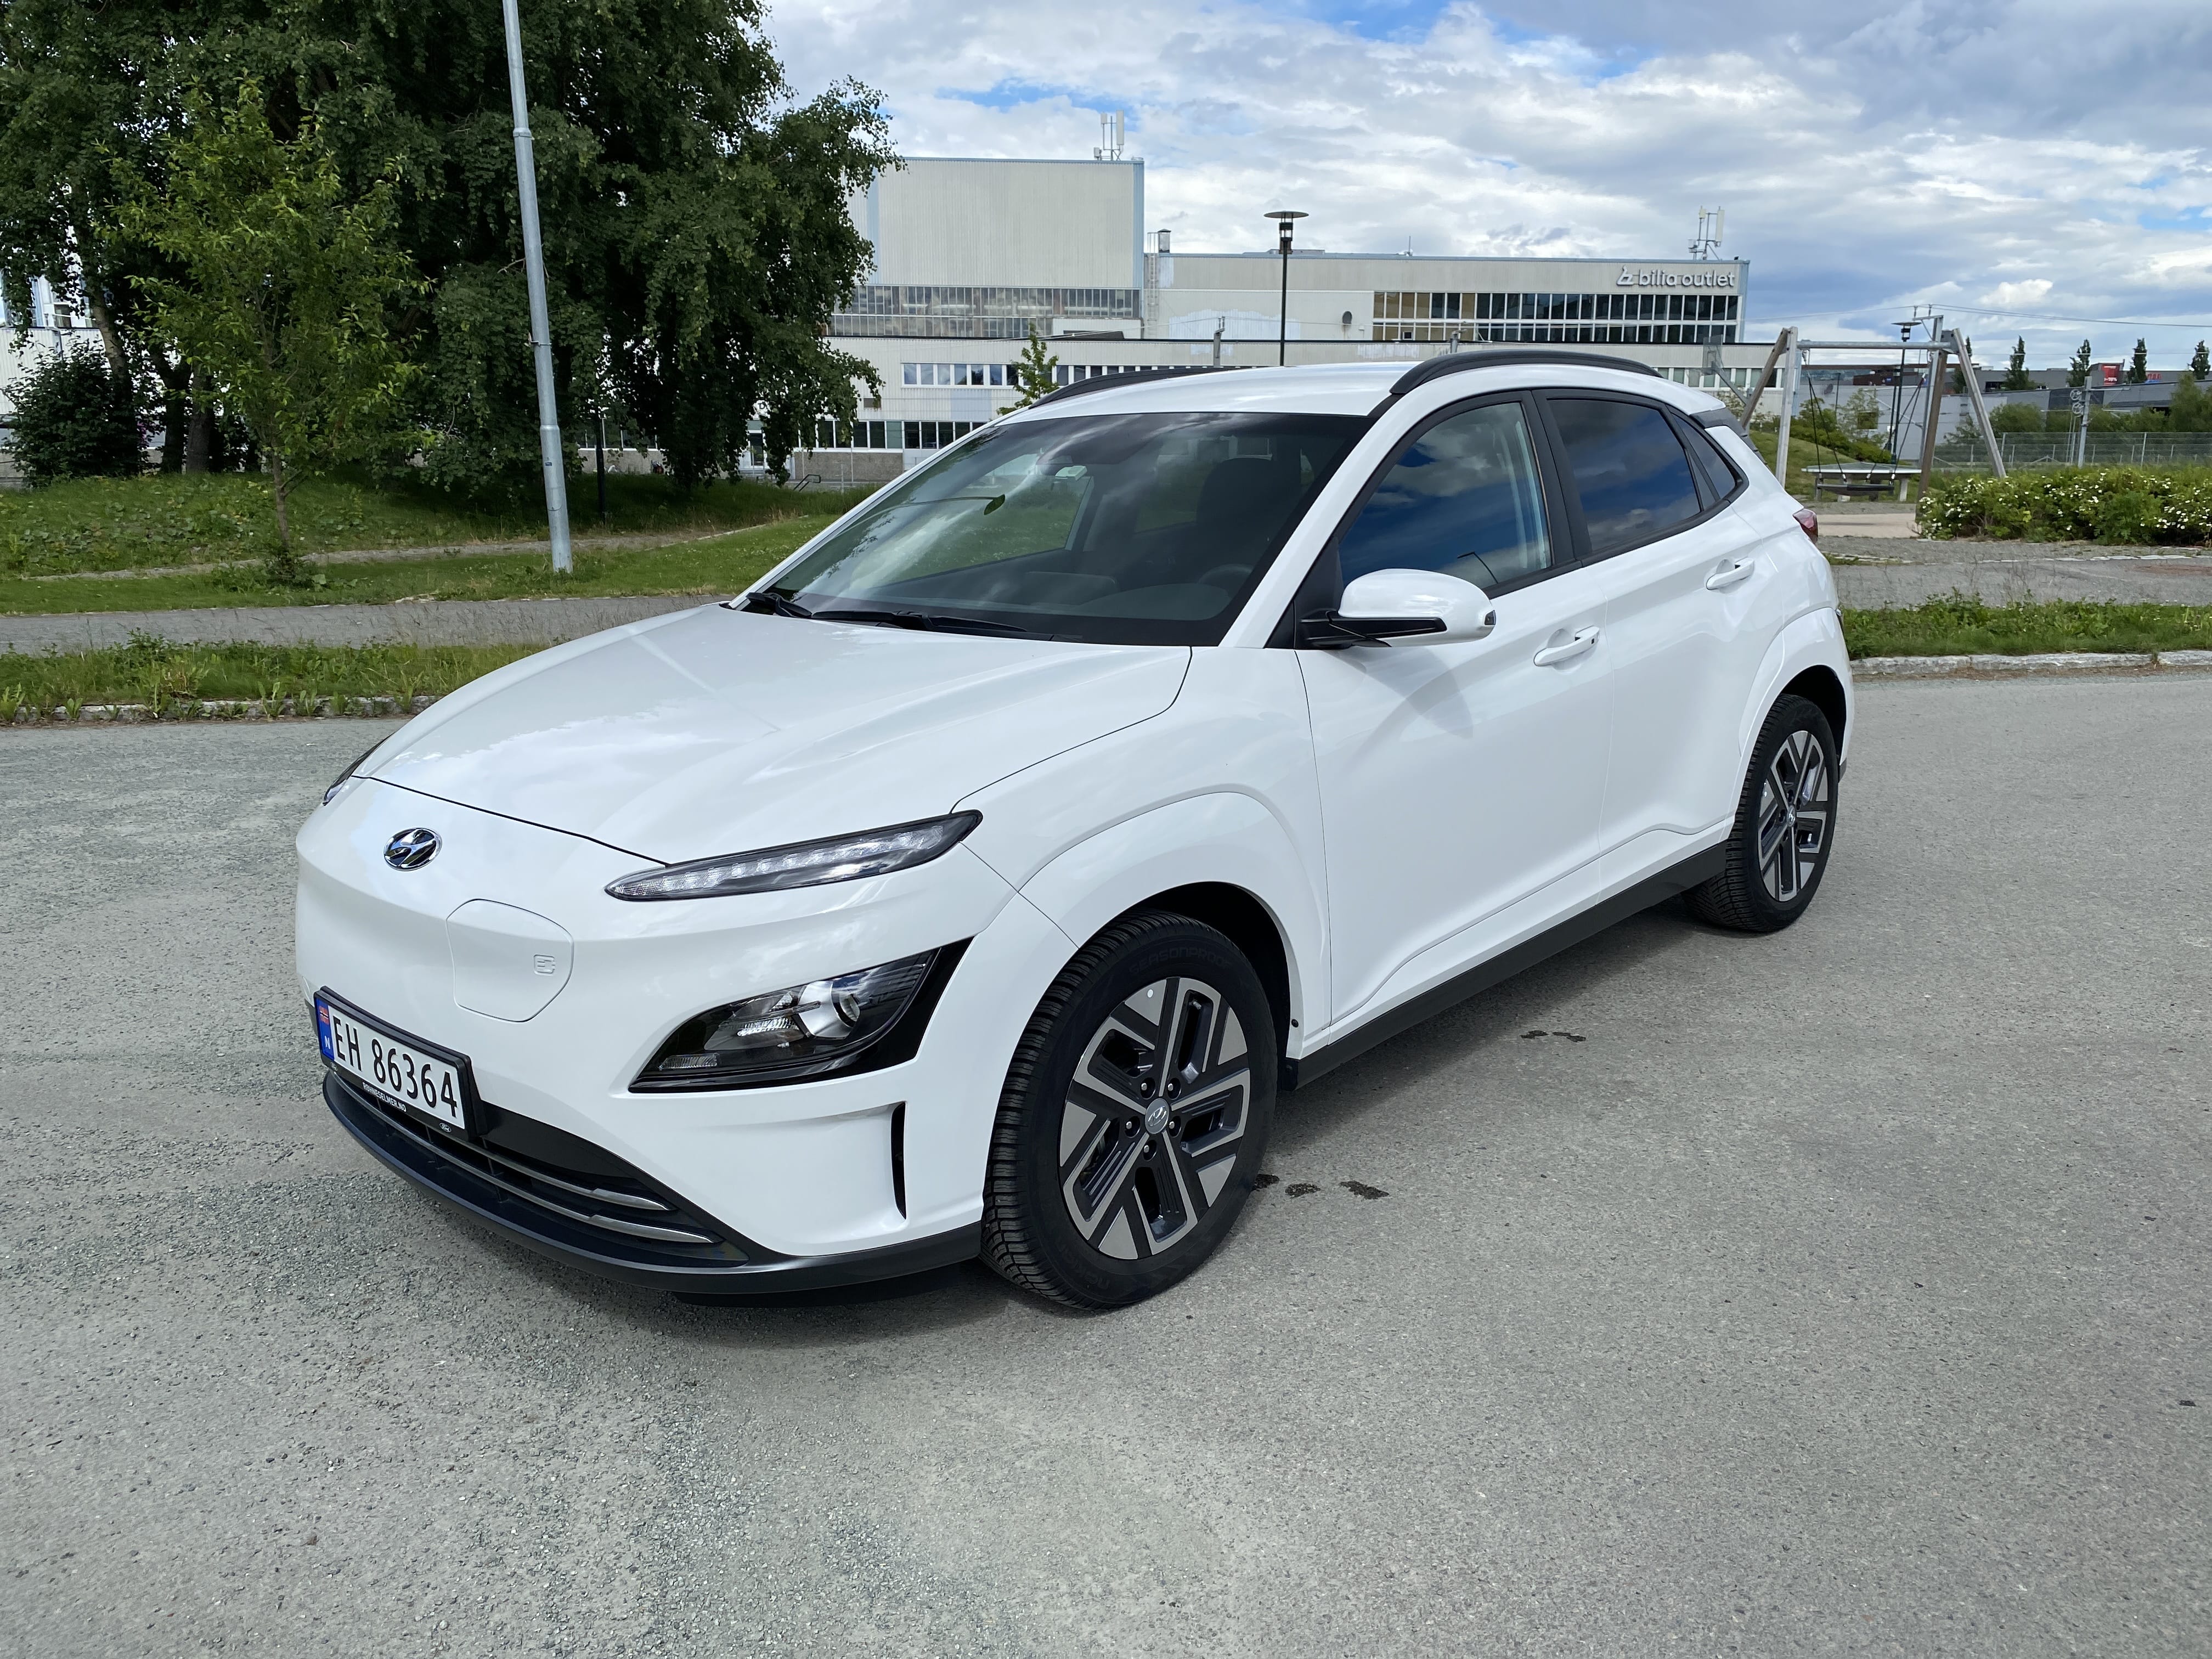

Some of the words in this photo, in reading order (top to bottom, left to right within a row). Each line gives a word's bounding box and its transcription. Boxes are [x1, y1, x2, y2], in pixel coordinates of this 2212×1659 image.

[1639, 269, 1677, 286] bilia
[1682, 270, 1735, 287] outlet
[324, 1035, 331, 1049] N
[332, 1015, 362, 1072] EH
[371, 1039, 458, 1118] 86364
